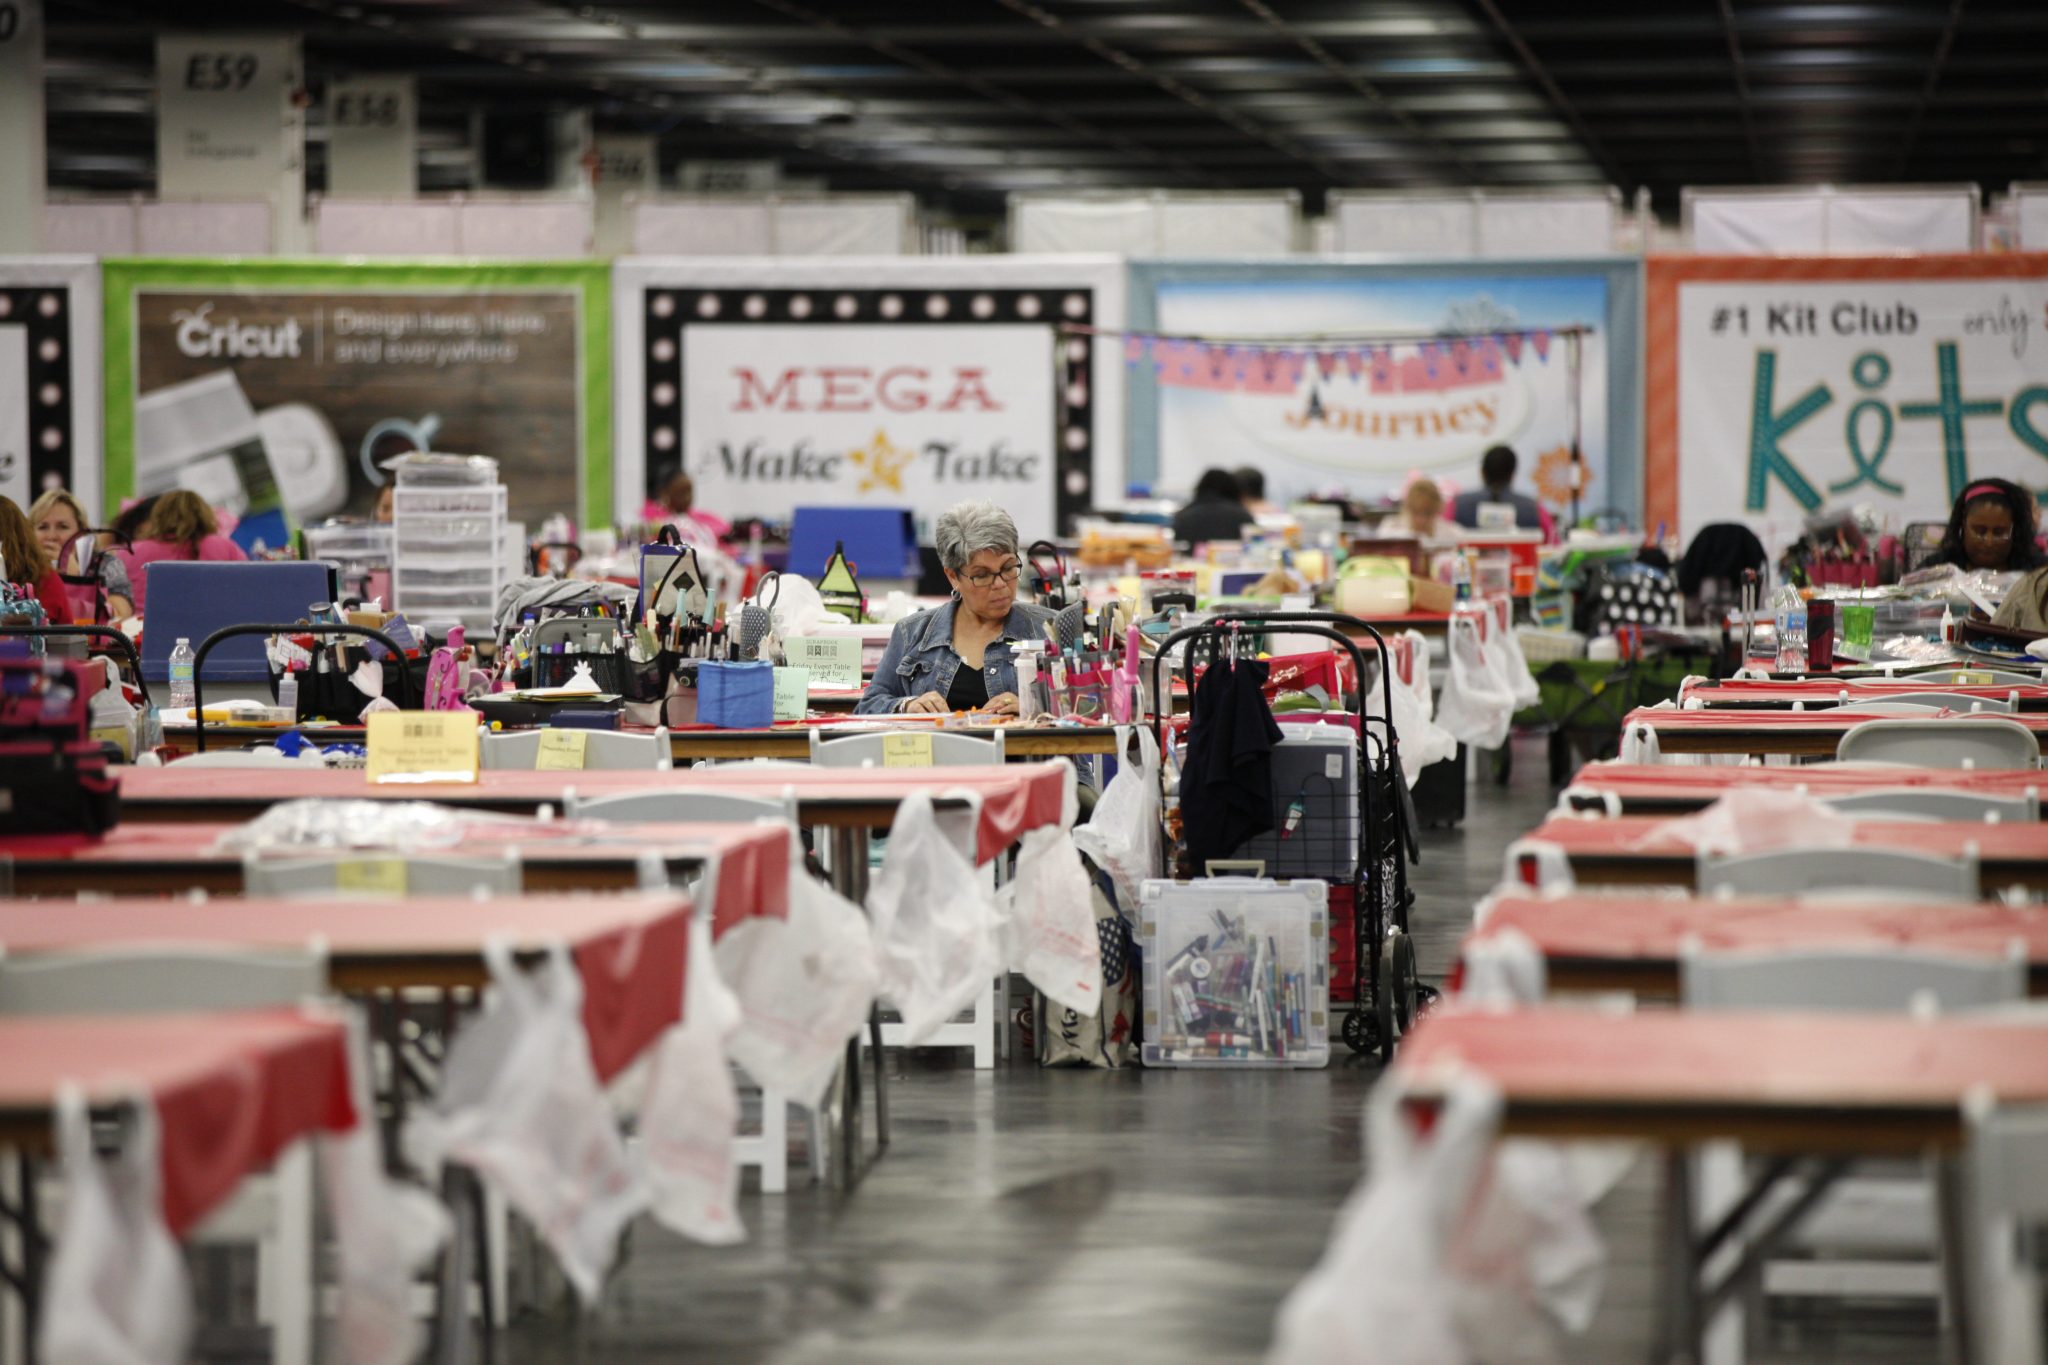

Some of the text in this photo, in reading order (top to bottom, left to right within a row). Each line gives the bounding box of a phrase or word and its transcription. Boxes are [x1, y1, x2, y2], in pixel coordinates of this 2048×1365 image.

[186, 55, 257, 90] E59
[171, 305, 301, 358] Cricut
[1711, 299, 1918, 335] #1 Kit Club
[1963, 294, 2035, 360] only
[730, 366, 1003, 413] MEGA
[1284, 388, 1502, 440] Journey
[703, 438, 843, 484] Make
[921, 438, 1040, 484] Take
[776, 692, 795, 700] Table
